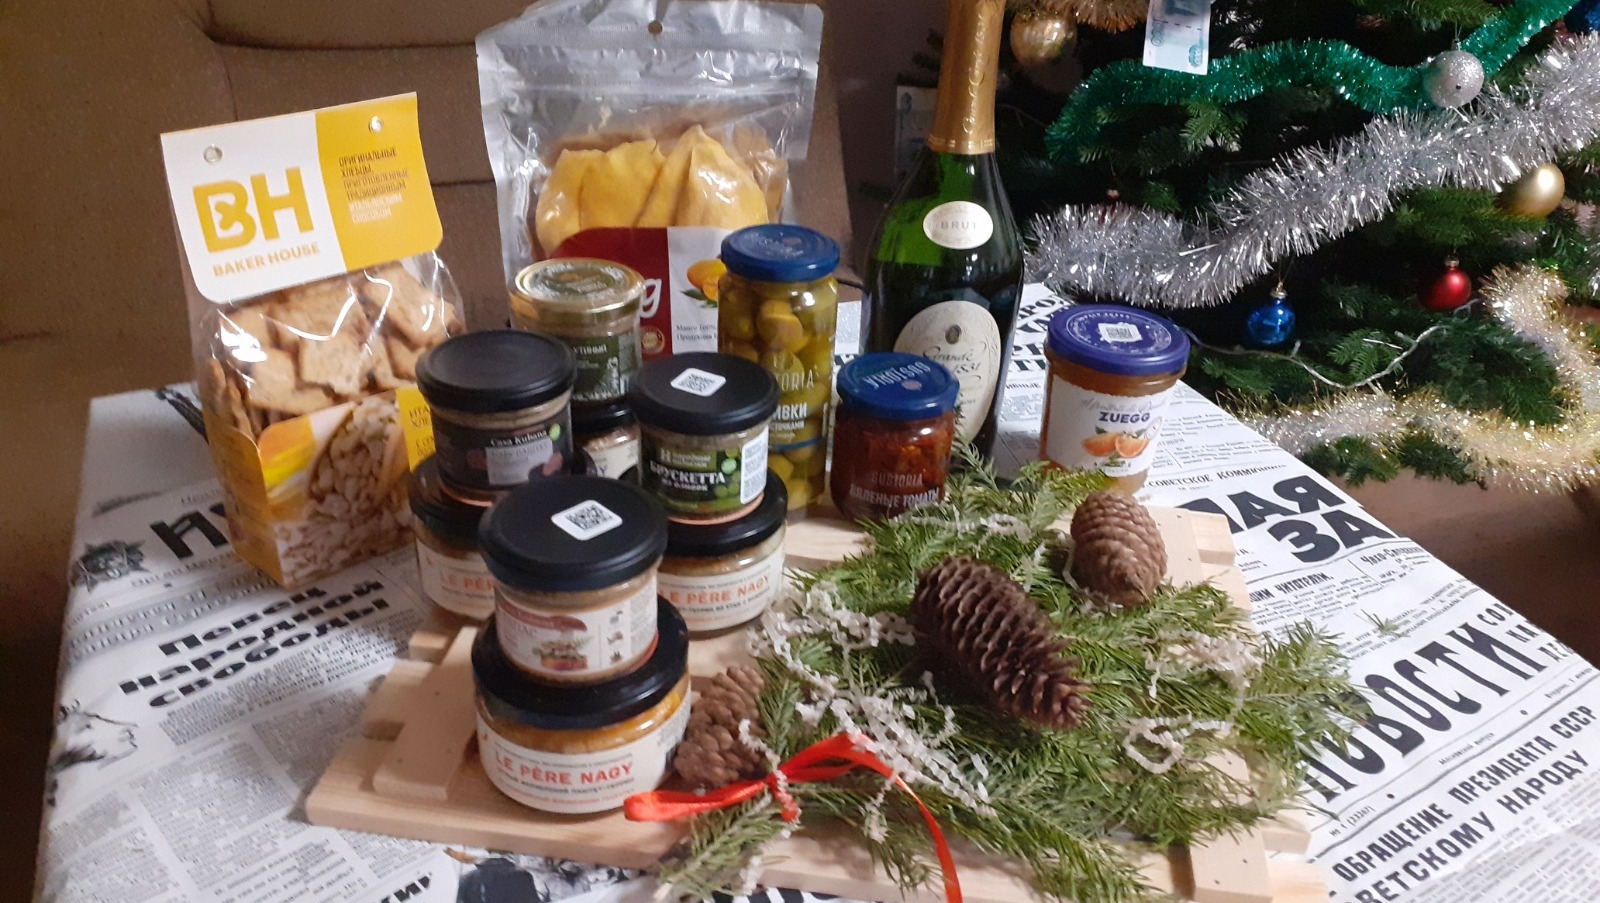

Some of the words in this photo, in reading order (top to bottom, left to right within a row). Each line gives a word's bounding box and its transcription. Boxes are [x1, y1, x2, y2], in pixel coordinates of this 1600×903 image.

[192, 165, 316, 254] BH
[941, 220, 977, 230] BRUT
[212, 254, 266, 277] BAKER
[267, 241, 319, 265] HOUSE
[863, 361, 931, 390] GUSTORIA
[1099, 411, 1151, 424] ZUEGG
[1267, 509, 1398, 563] ЗА
[520, 763, 574, 786] PÈRE
[580, 761, 634, 785] NAGY
[1496, 749, 1590, 815] НАРОДУ
[1332, 802, 1454, 882] ОБРАЩЕНИЕ
[1447, 735, 1558, 805] ПРЕЗИДЕНТА
[1550, 705, 1598, 739] СССР
